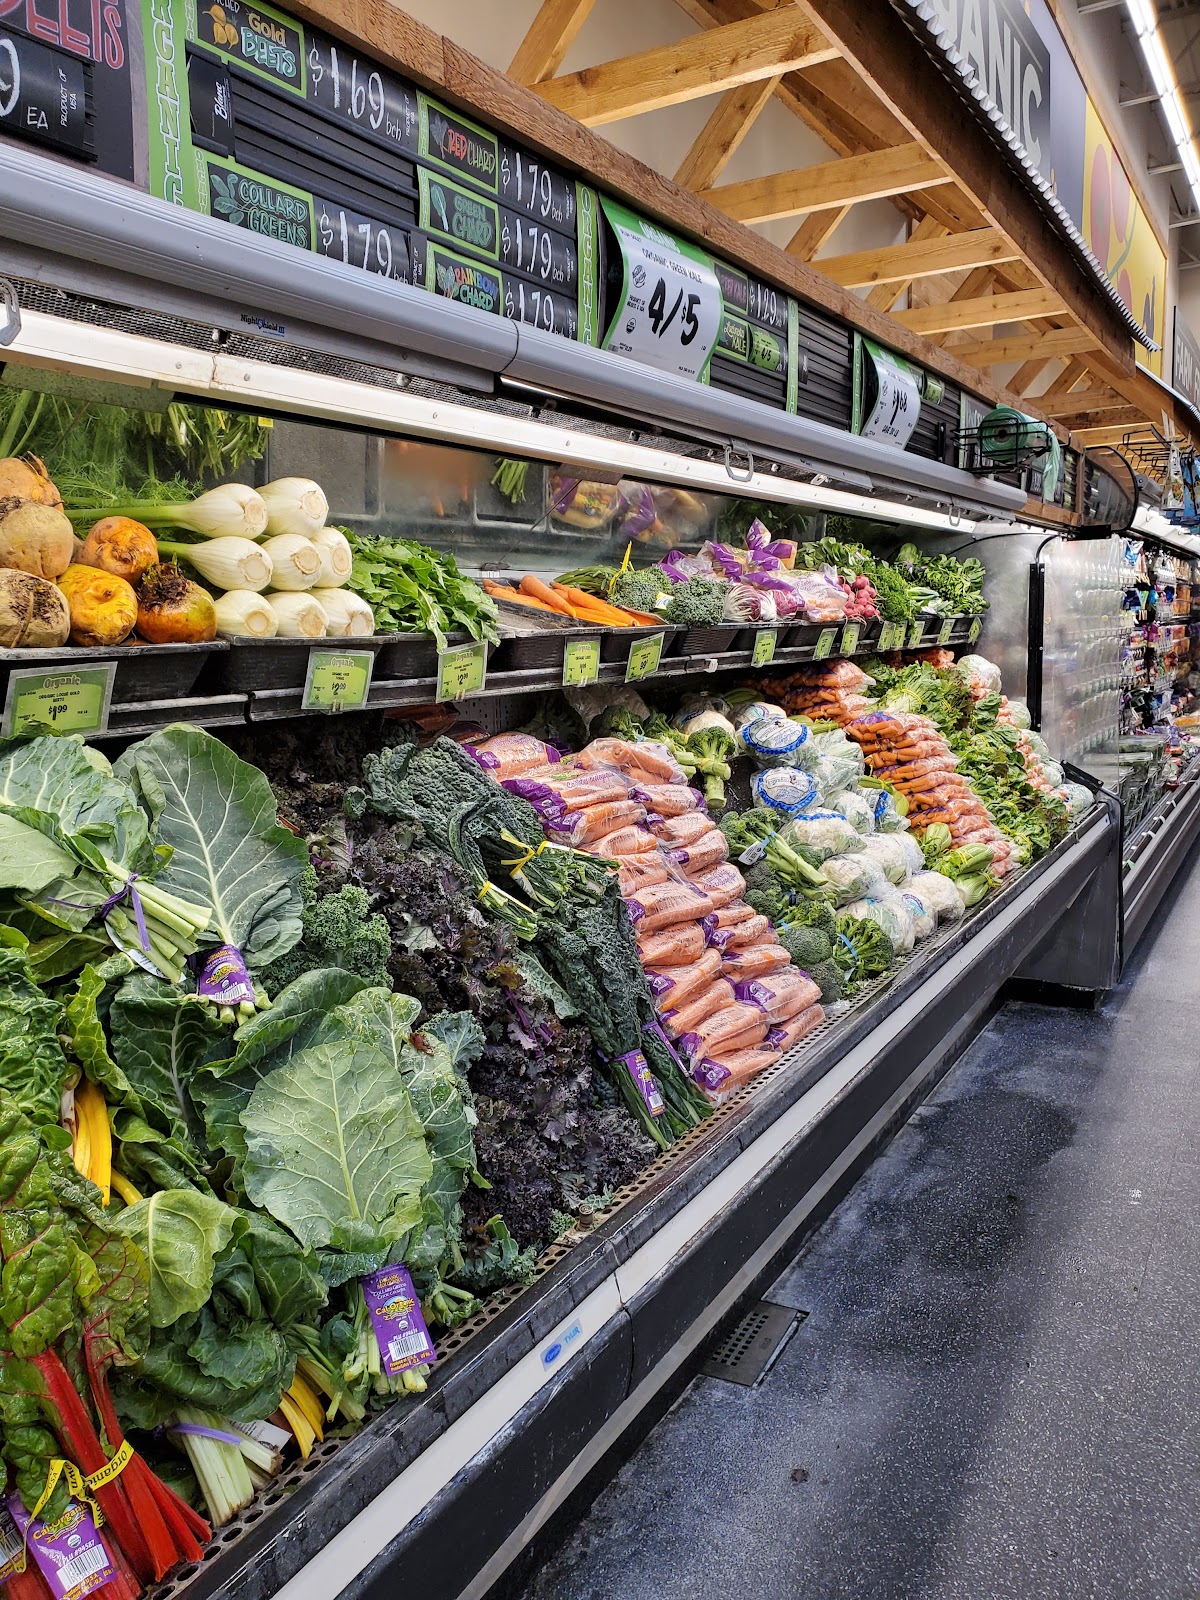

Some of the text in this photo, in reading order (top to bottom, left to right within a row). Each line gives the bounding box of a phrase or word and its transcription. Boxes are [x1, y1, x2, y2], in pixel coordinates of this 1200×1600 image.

[248, 13, 287, 47] Gold
[241, 27, 296, 78] BEETS
[58, 68, 68, 127] PRODUCT OF
[69, 93, 77, 110] USA
[214, 81, 228, 120] Blanc
[309, 38, 402, 141] $1.69 bch
[27, 106, 48, 130] EA
[447, 128, 495, 175] RED CHARD
[239, 178, 309, 222] COLLARD
[501, 147, 563, 223] $1.79 bch
[454, 195, 487, 220] GREEN
[248, 208, 308, 249] GREENS
[452, 211, 493, 248] CHARD
[501, 216, 564, 283] $1.79 bch
[454, 266, 498, 301] RAINBOW
[459, 284, 494, 311] CHARD
[731, 336, 747, 353] KALE
[1175, 334, 1193, 396] FARM
[331, 656, 355, 668] Organic
[42, 673, 82, 690] Organic
[375, 1297, 416, 1316] Cal-Organic
[563, 1326, 581, 1344] TYLER
